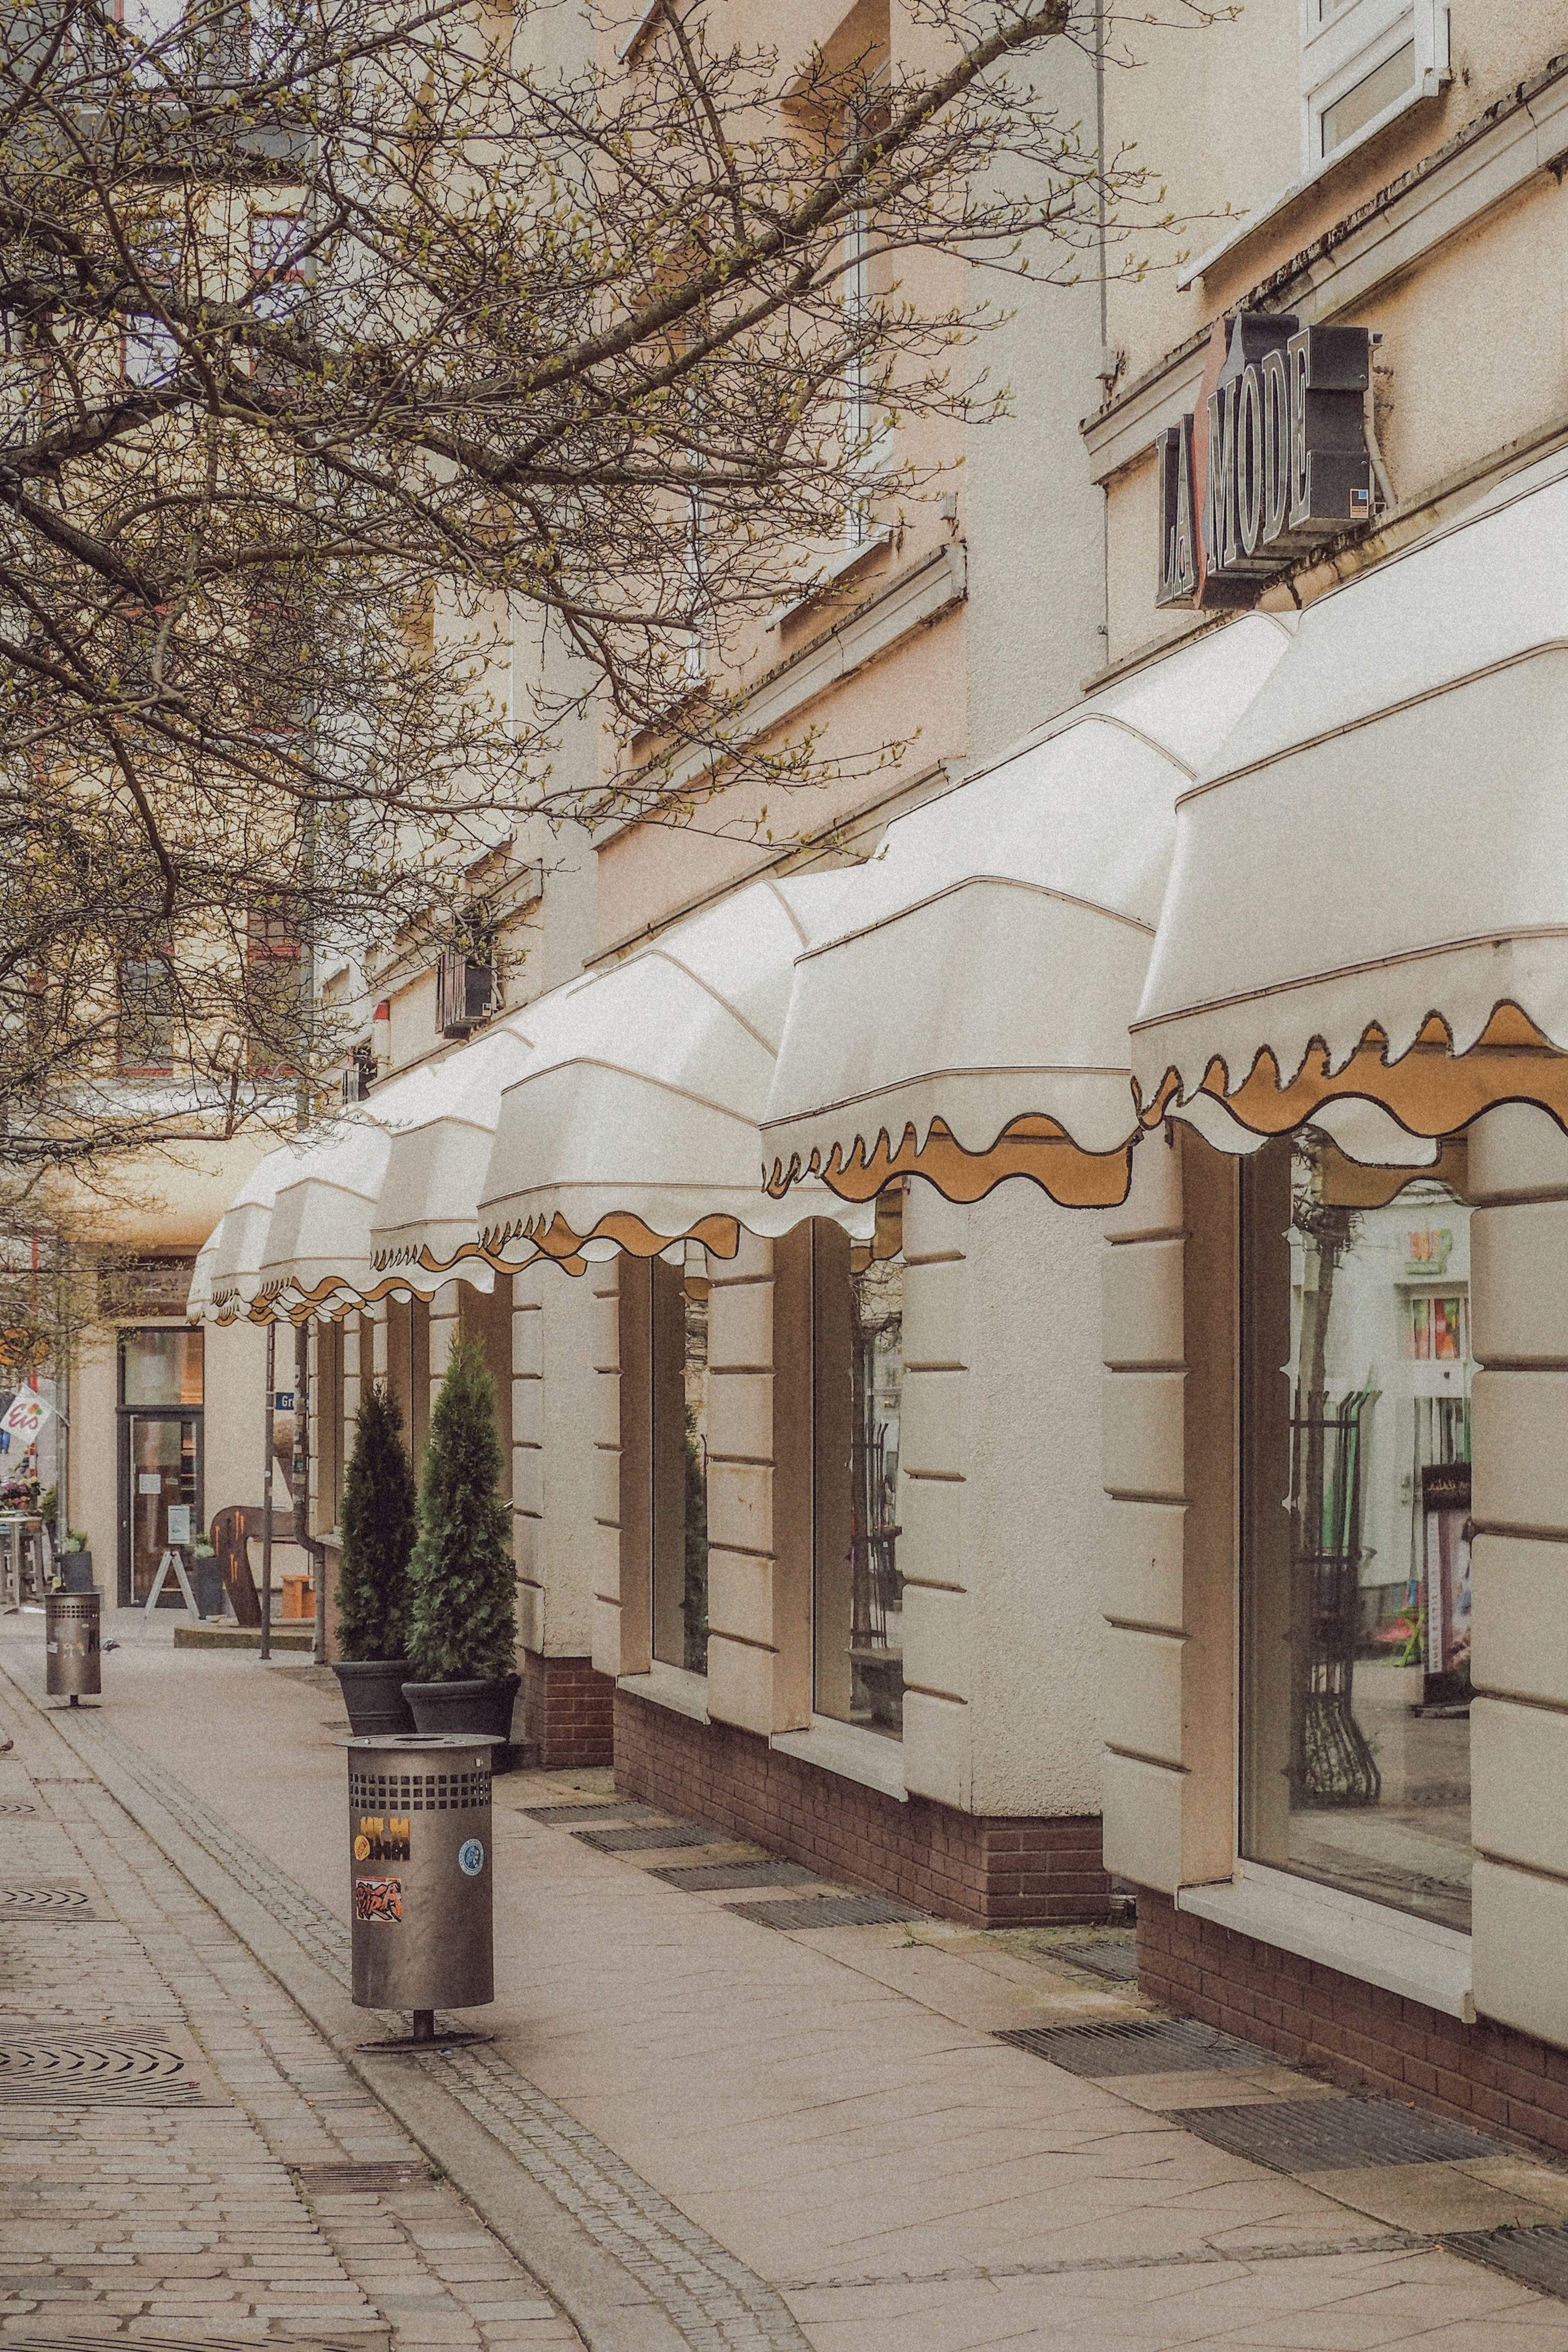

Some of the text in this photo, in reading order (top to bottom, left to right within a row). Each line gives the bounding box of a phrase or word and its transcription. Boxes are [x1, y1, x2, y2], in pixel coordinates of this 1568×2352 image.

[1156, 327, 1311, 608] LA MODE
[282, 1395, 292, 1407] Gr
[9, 1403, 41, 1430] Eis
